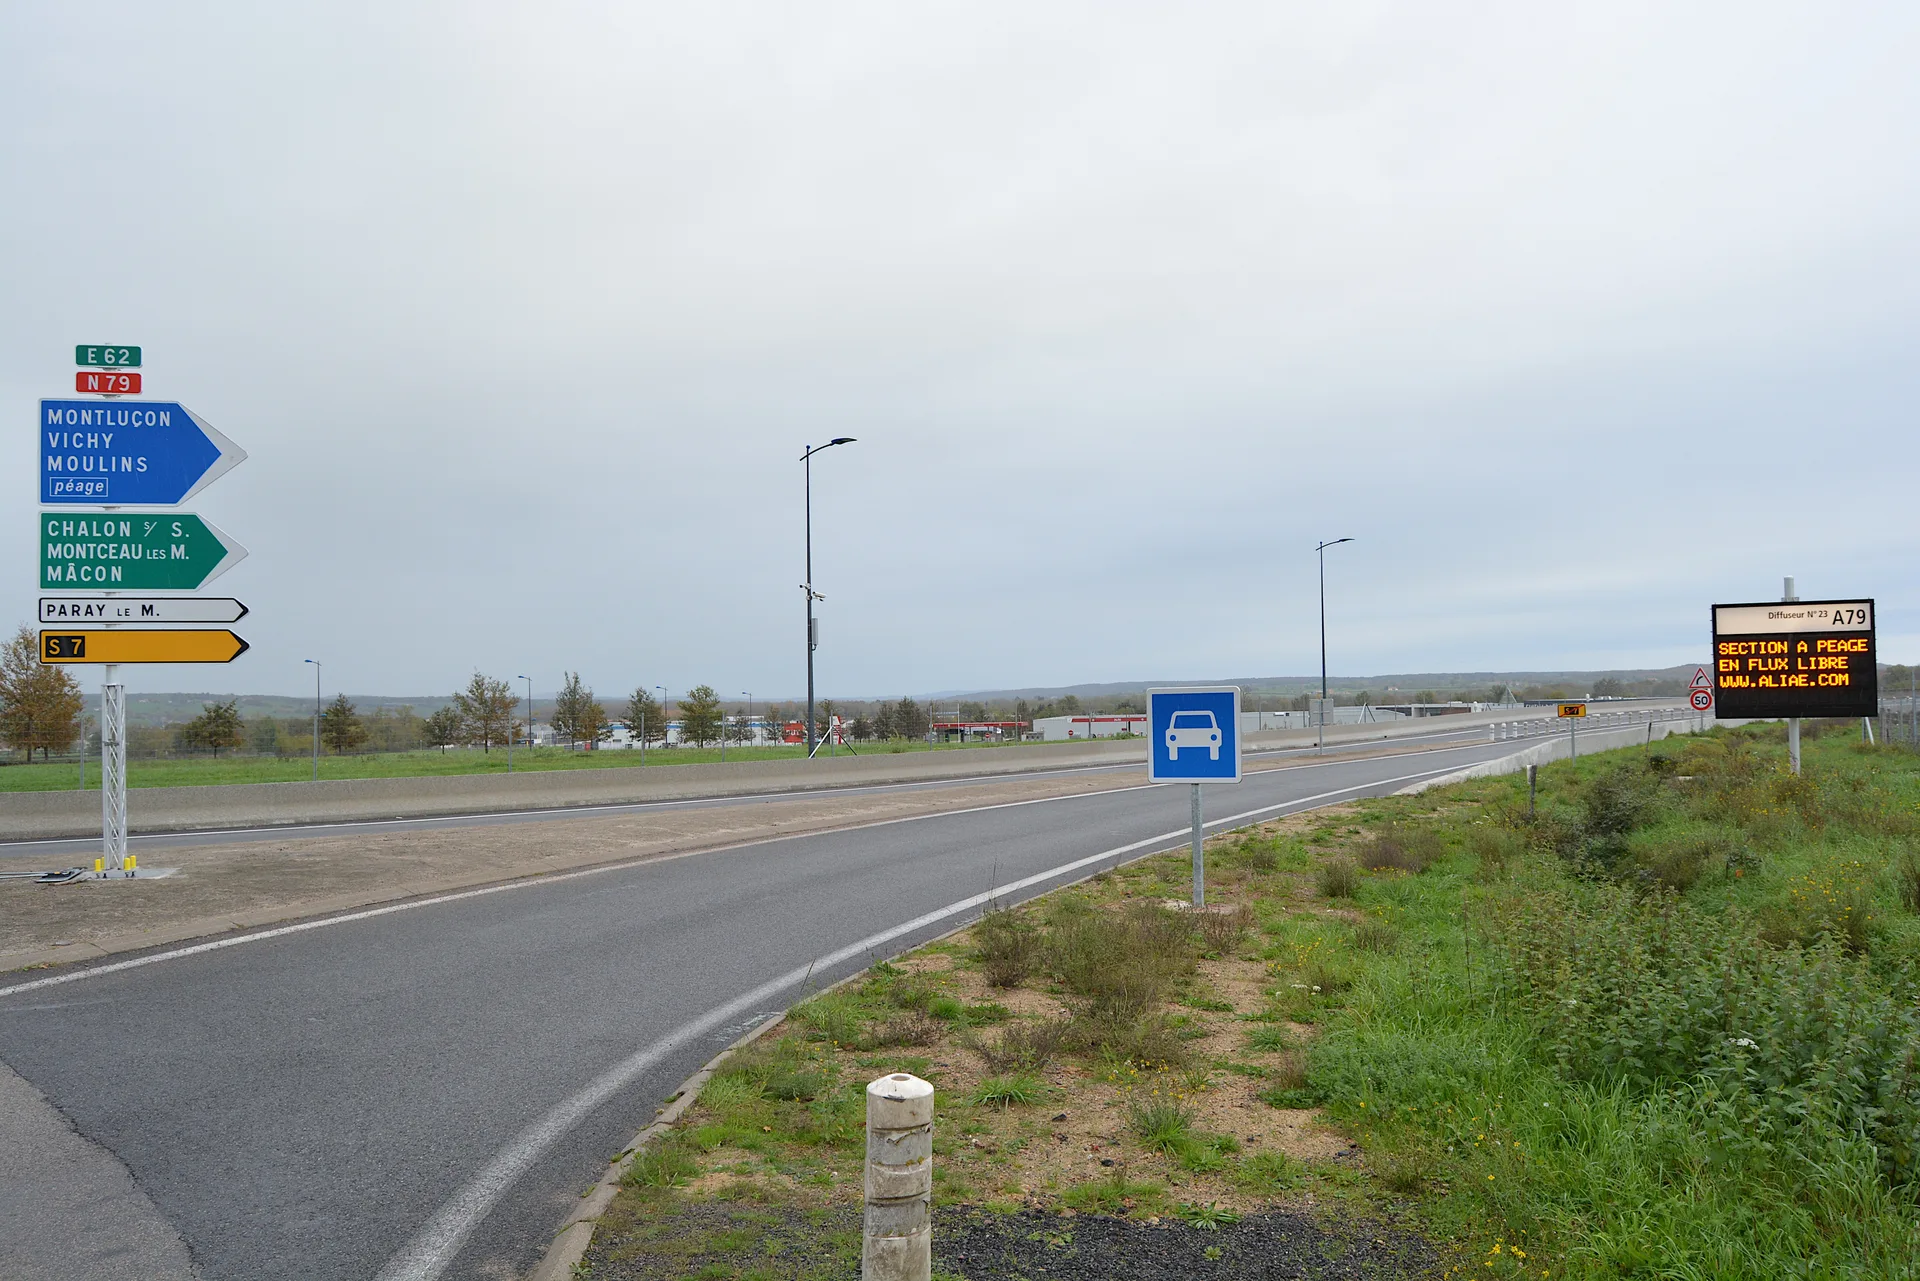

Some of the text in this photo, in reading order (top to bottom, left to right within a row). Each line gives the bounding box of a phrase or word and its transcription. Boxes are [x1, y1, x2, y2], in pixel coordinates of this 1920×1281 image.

[87, 348, 130, 364] E 62
[88, 375, 130, 391] N 79
[48, 409, 171, 427] MONTLUÇON
[48, 432, 113, 449] VICHY
[47, 455, 148, 472] MOULINS
[54, 479, 104, 495] péage
[47, 521, 131, 537] CHALON
[171, 521, 190, 538] S.
[47, 543, 190, 560] MONTCEAU LES M.
[47, 563, 122, 582] MÂCON
[46, 604, 160, 617] PARAY LE M.
[1768, 611, 1805, 619] Diffuseur
[1832, 609, 1866, 625] A79
[49, 639, 82, 655] S 7
[1718, 639, 1868, 655] SECTION A PEAGE
[1719, 657, 1849, 672] EN FLUX LIBRE
[1719, 673, 1849, 688] WWW.ALIAE.COM
[1694, 696, 1708, 705] 50
